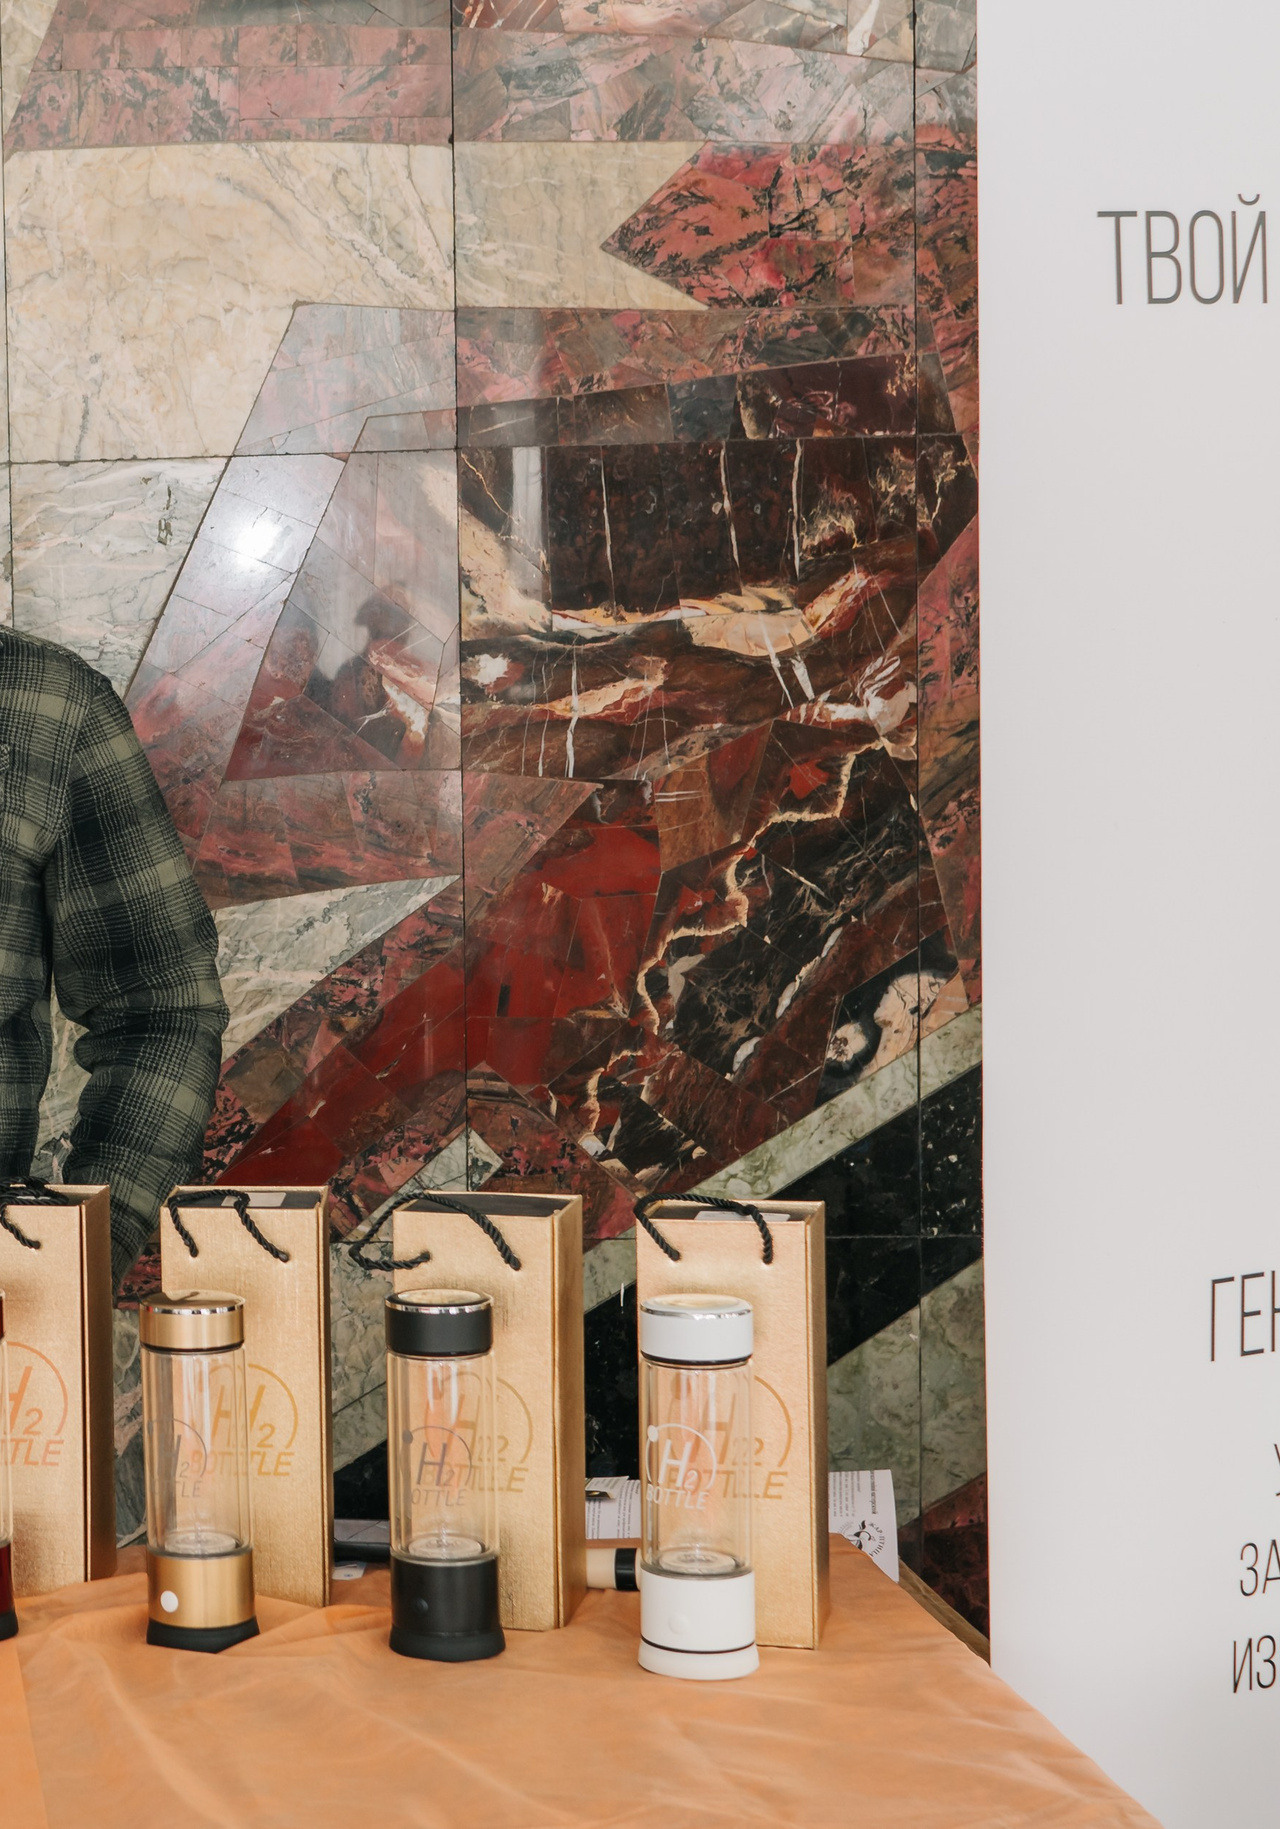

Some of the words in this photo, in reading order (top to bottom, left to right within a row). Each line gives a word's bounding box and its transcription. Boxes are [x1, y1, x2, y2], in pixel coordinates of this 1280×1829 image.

[1096, 192, 1269, 306] ТВОЙ
[416, 1441, 456, 1488] H2
[657, 1438, 700, 1490] H2
[410, 1487, 467, 1507] OTTLE
[646, 1482, 710, 1511] BOTTLE
[1232, 1634, 1277, 1694] ИЗ
